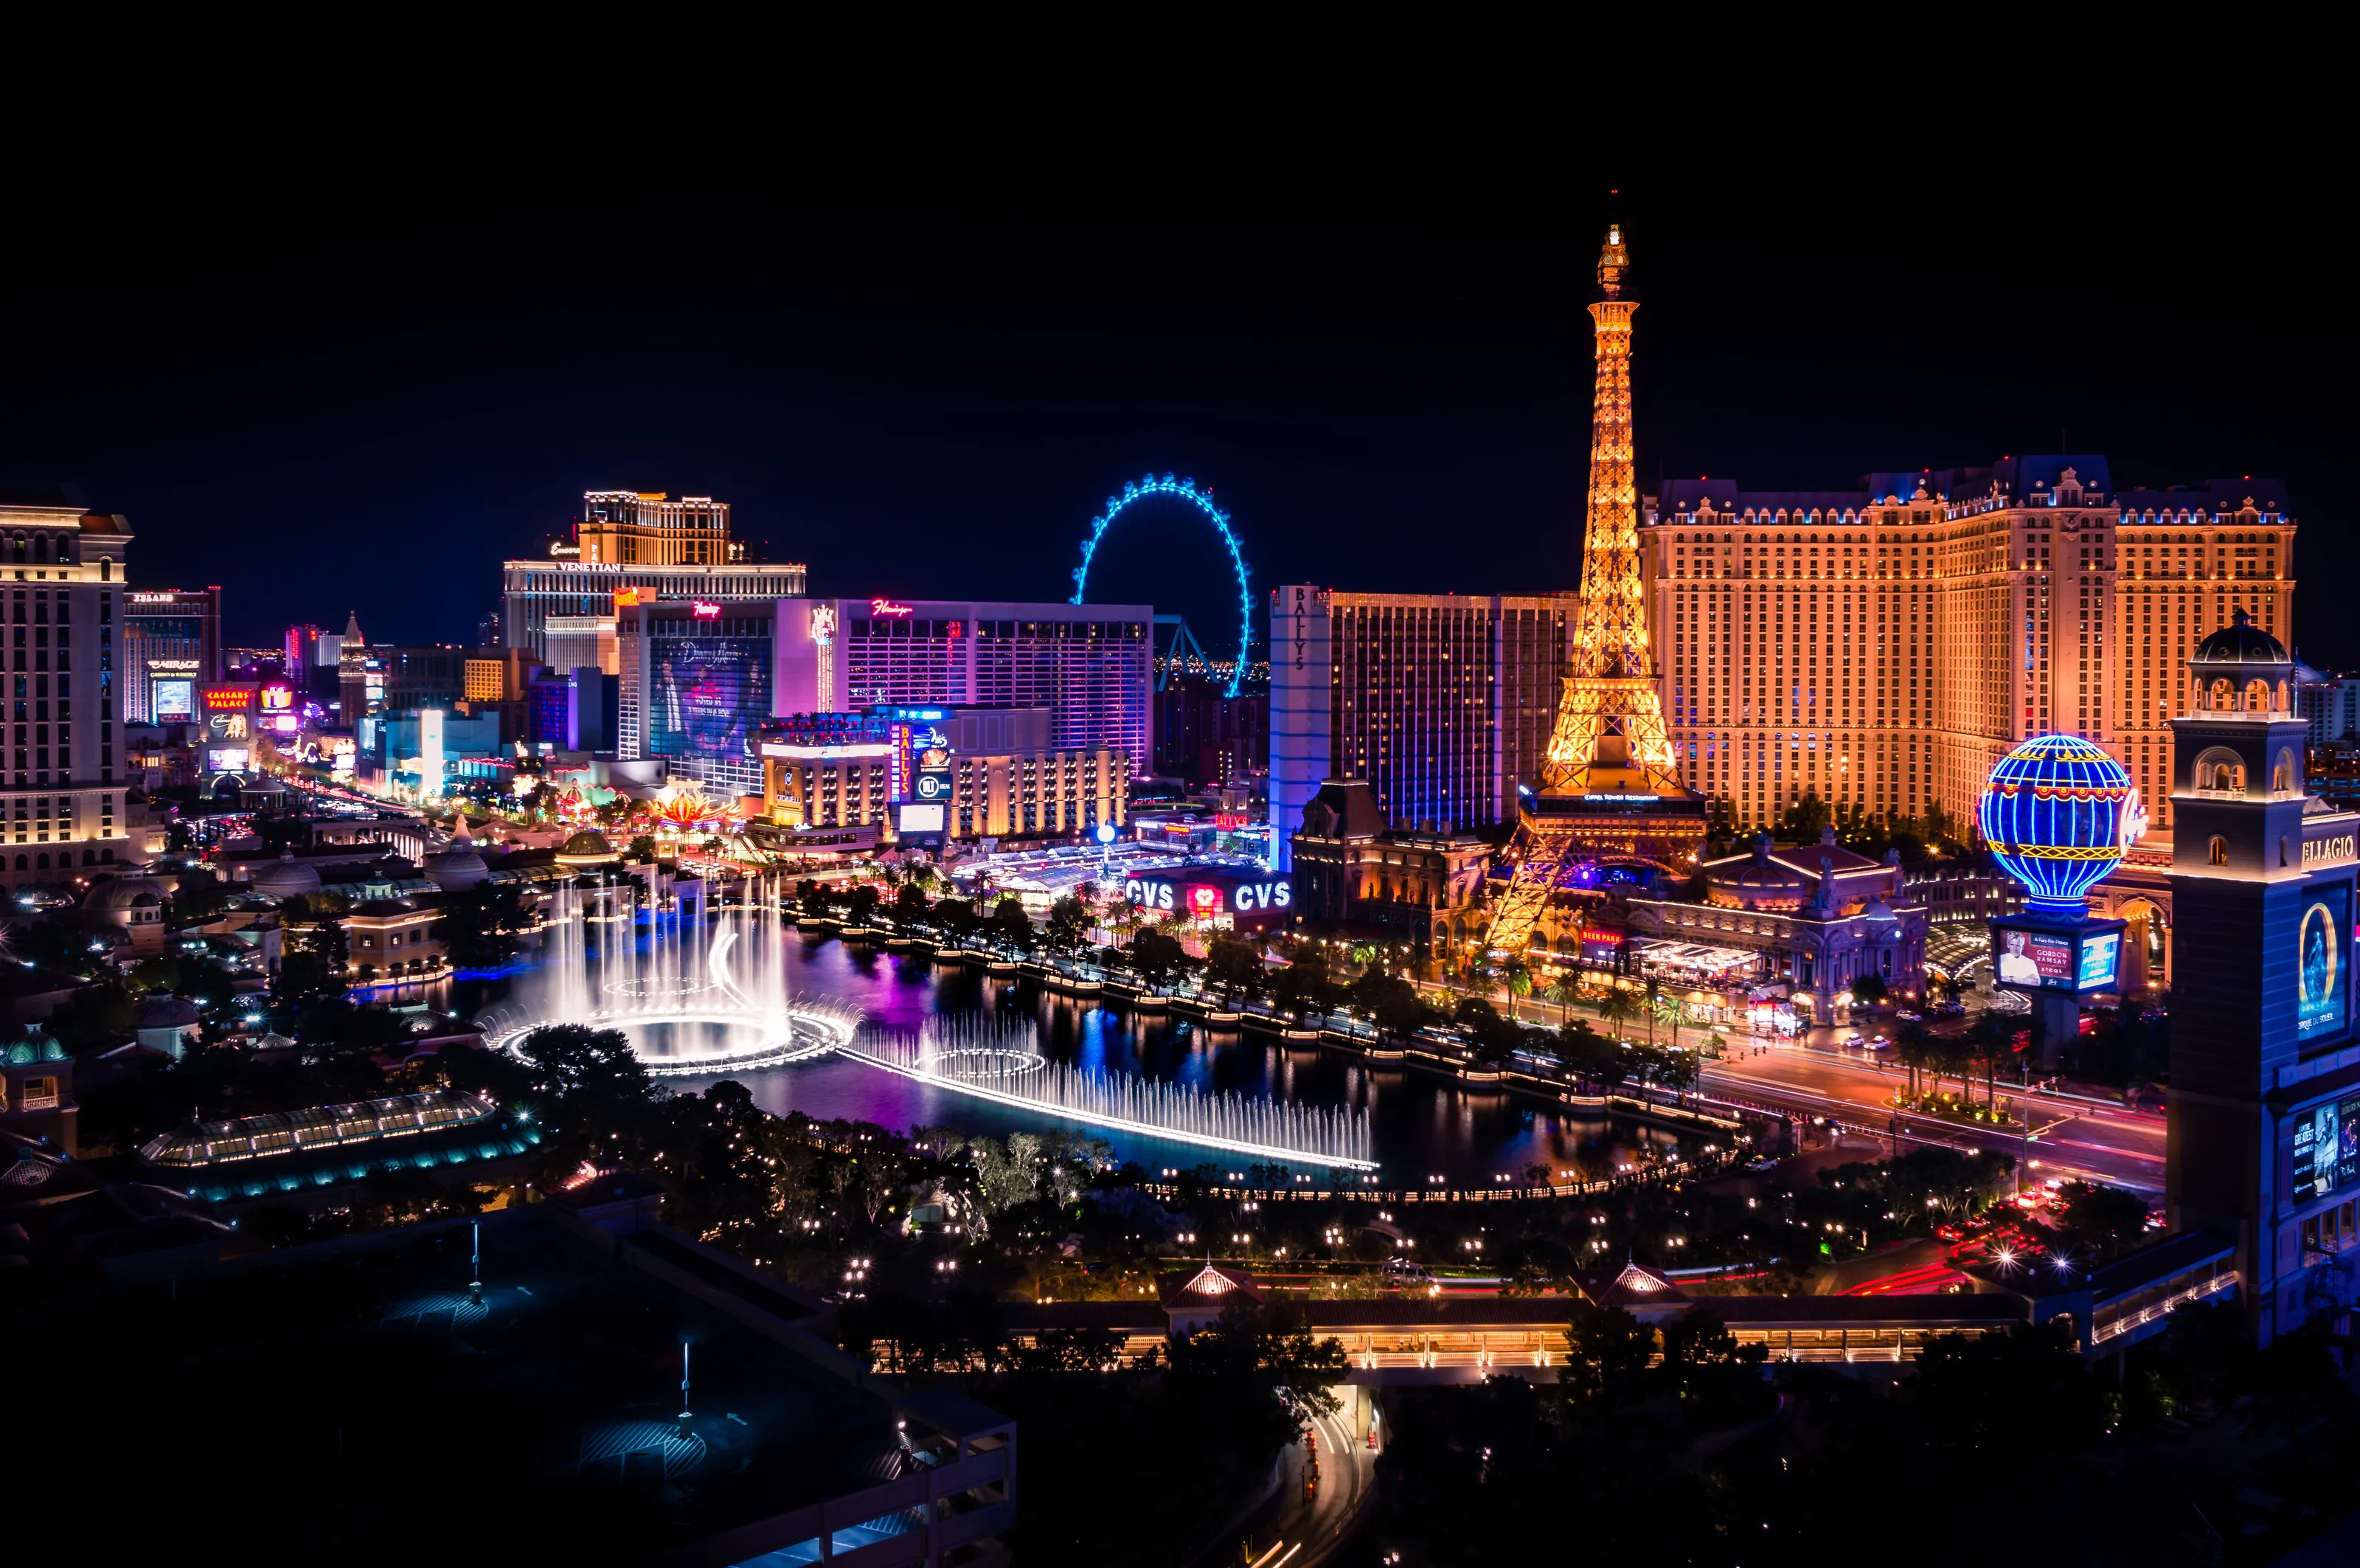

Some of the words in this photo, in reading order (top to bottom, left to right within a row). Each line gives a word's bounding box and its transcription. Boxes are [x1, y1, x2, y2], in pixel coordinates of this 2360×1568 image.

[559, 561, 621, 572] VENETIAN
[133, 594, 174, 603] ISLAND
[872, 599, 913, 617] Flamingo
[1294, 587, 1306, 671] BALLYS
[159, 660, 200, 669] MIRAGE
[206, 691, 249, 699] CAESARS
[209, 700, 248, 708] PALACE
[900, 726, 910, 794] BALLYS
[2302, 834, 2354, 863] ELLAGIO
[1125, 879, 1173, 909] CVS
[1235, 881, 1291, 911] CVS
[1583, 932, 1601, 940] BEER
[1602, 934, 1620, 943] PARK
[2036, 949, 2067, 959] GORDON
[2036, 956, 2067, 965] RAMSAY
